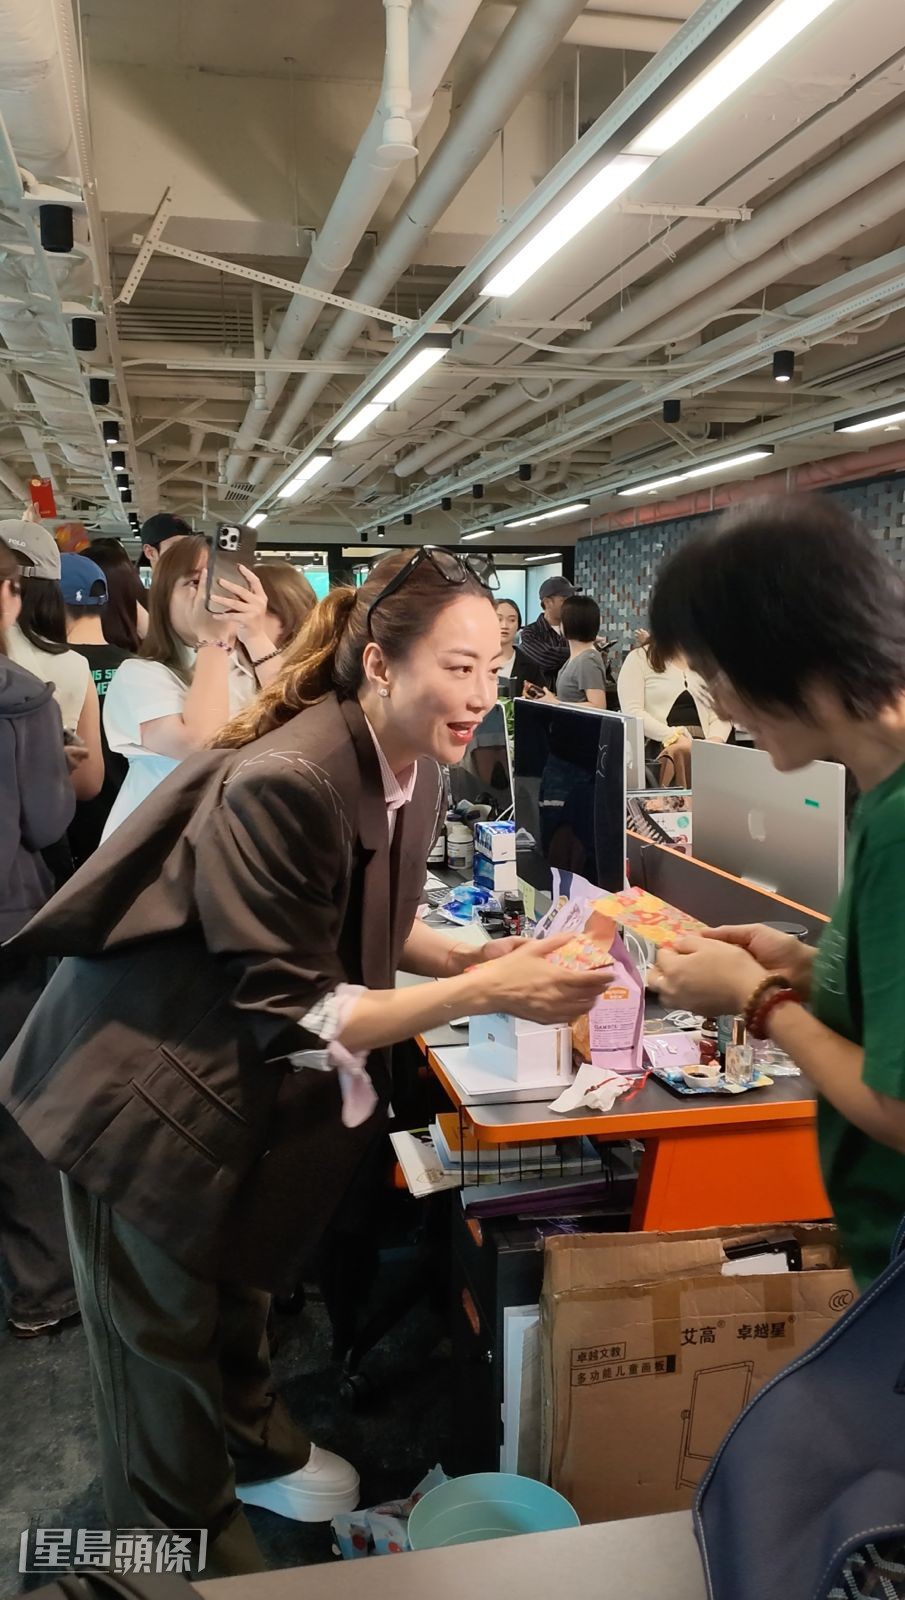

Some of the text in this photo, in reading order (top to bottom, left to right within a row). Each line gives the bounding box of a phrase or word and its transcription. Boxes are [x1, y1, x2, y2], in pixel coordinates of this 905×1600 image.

[680, 1321, 786, 1346] 艾高 卓越星
[576, 1346, 621, 1363] 卓越文教
[576, 1360, 665, 1384] 多功能儿童画板
